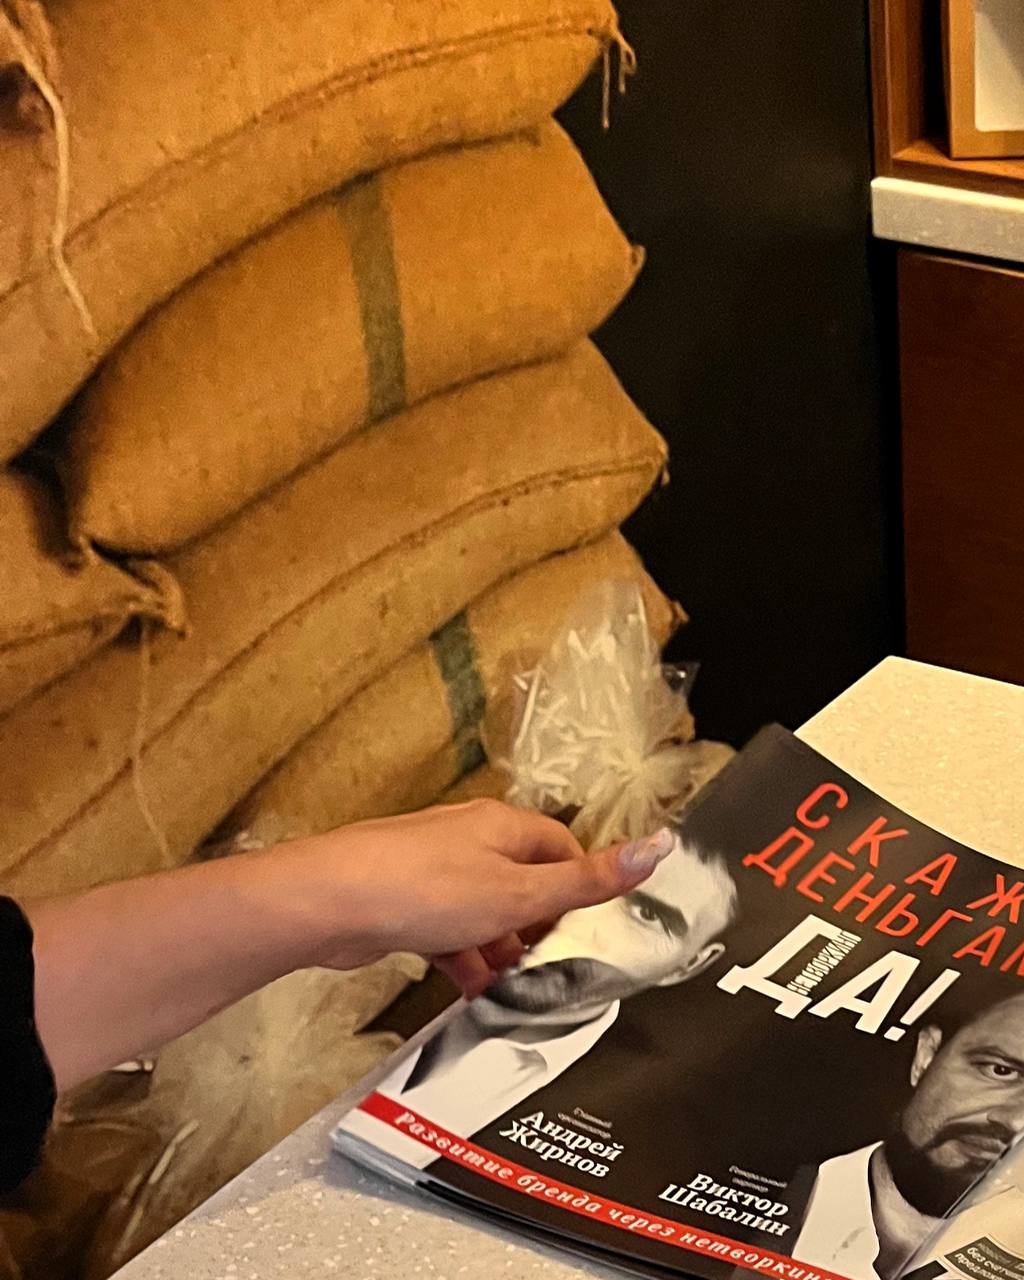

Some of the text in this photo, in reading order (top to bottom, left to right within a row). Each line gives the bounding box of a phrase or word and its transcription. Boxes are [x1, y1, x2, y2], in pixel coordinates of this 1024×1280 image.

[716, 913, 962, 1042] ДА!
[498, 1120, 611, 1178] Жирнов
[519, 1110, 625, 1162] Андрей
[516, 1172, 602, 1213] бренда
[608, 1205, 674, 1238] через
[658, 1183, 792, 1237] Шабалин
[686, 1172, 790, 1218] Виктор
